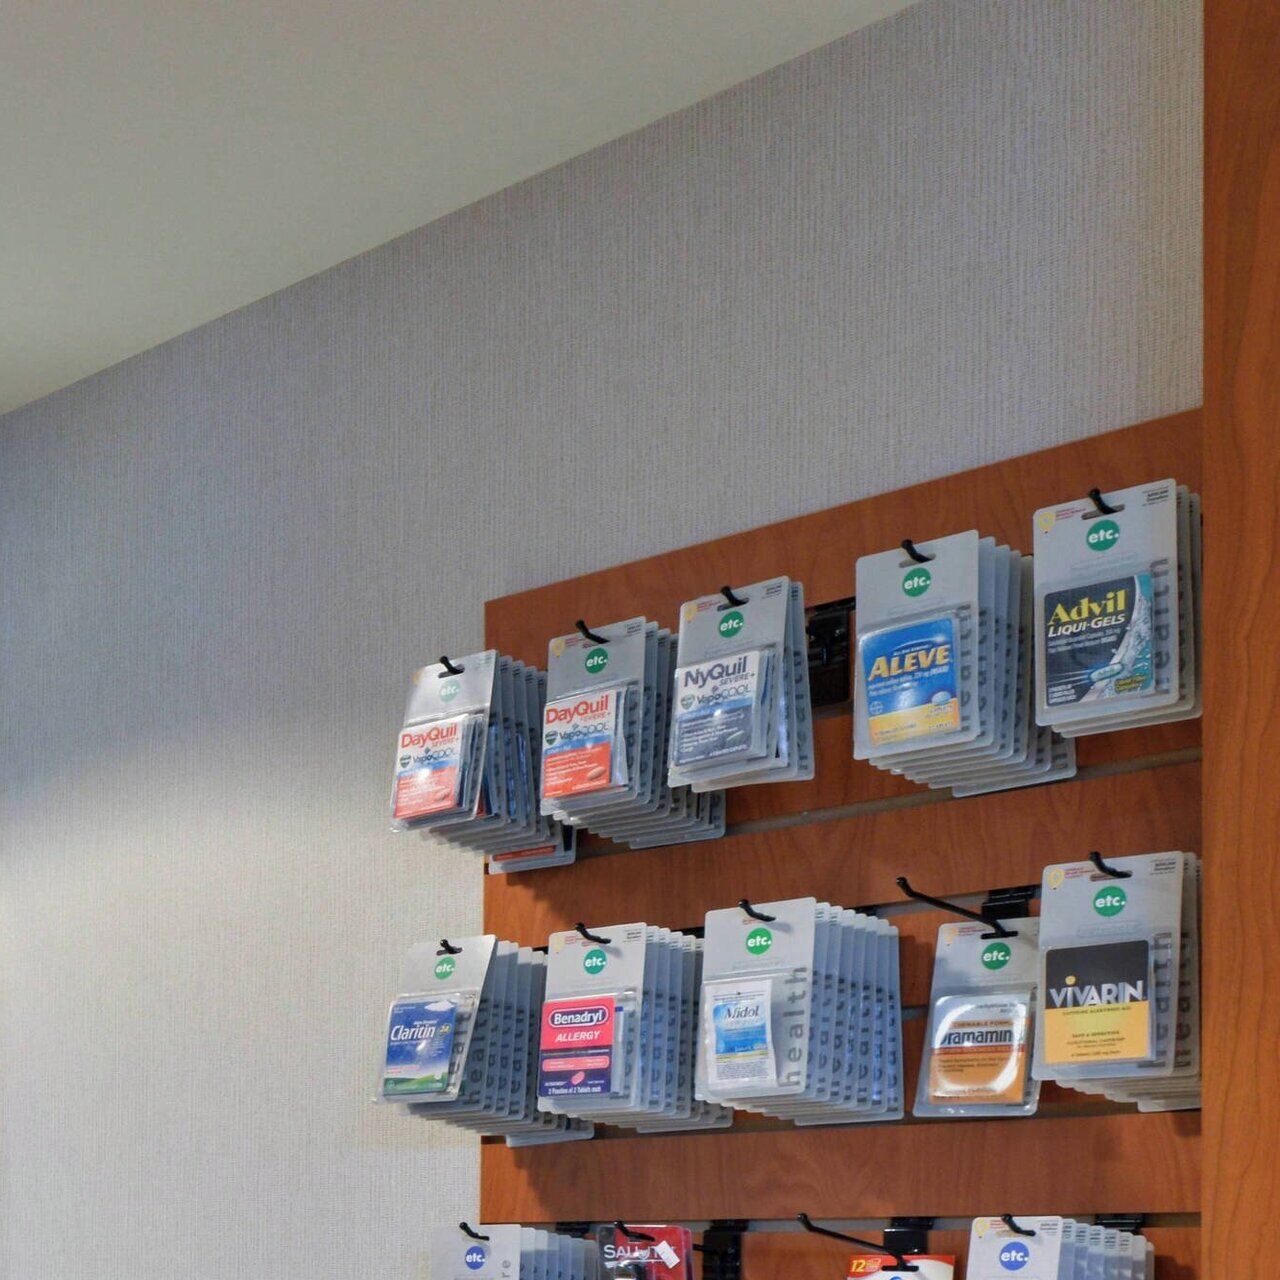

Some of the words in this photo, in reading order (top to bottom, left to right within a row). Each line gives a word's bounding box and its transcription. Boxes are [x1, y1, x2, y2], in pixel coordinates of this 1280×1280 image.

[1088, 528, 1120, 544] etc.
[904, 575, 931, 590] etc.
[1047, 589, 1127, 626] Advil
[720, 619, 743, 632] etc.
[585, 654, 609, 668] etc.
[868, 645, 951, 681] ALEVE
[684, 656, 747, 688] NyQuil
[441, 683, 459, 697] etc.
[546, 695, 608, 725] DayQuil
[401, 722, 457, 749] DayQuil
[1095, 895, 1126, 908] etc.
[748, 934, 772, 949] etc.
[584, 955, 606, 968] etc.
[983, 951, 1010, 962] etc.
[434, 963, 456, 974] etc.
[554, 1010, 603, 1025] Benadryl
[391, 1025, 435, 1041] Claritin
[779, 966, 808, 1087] health
[555, 1030, 601, 1042] ALLERGY
[465, 1251, 486, 1264] etc.
[1000, 1248, 1029, 1263] etc.
[851, 1259, 866, 1273] 12
